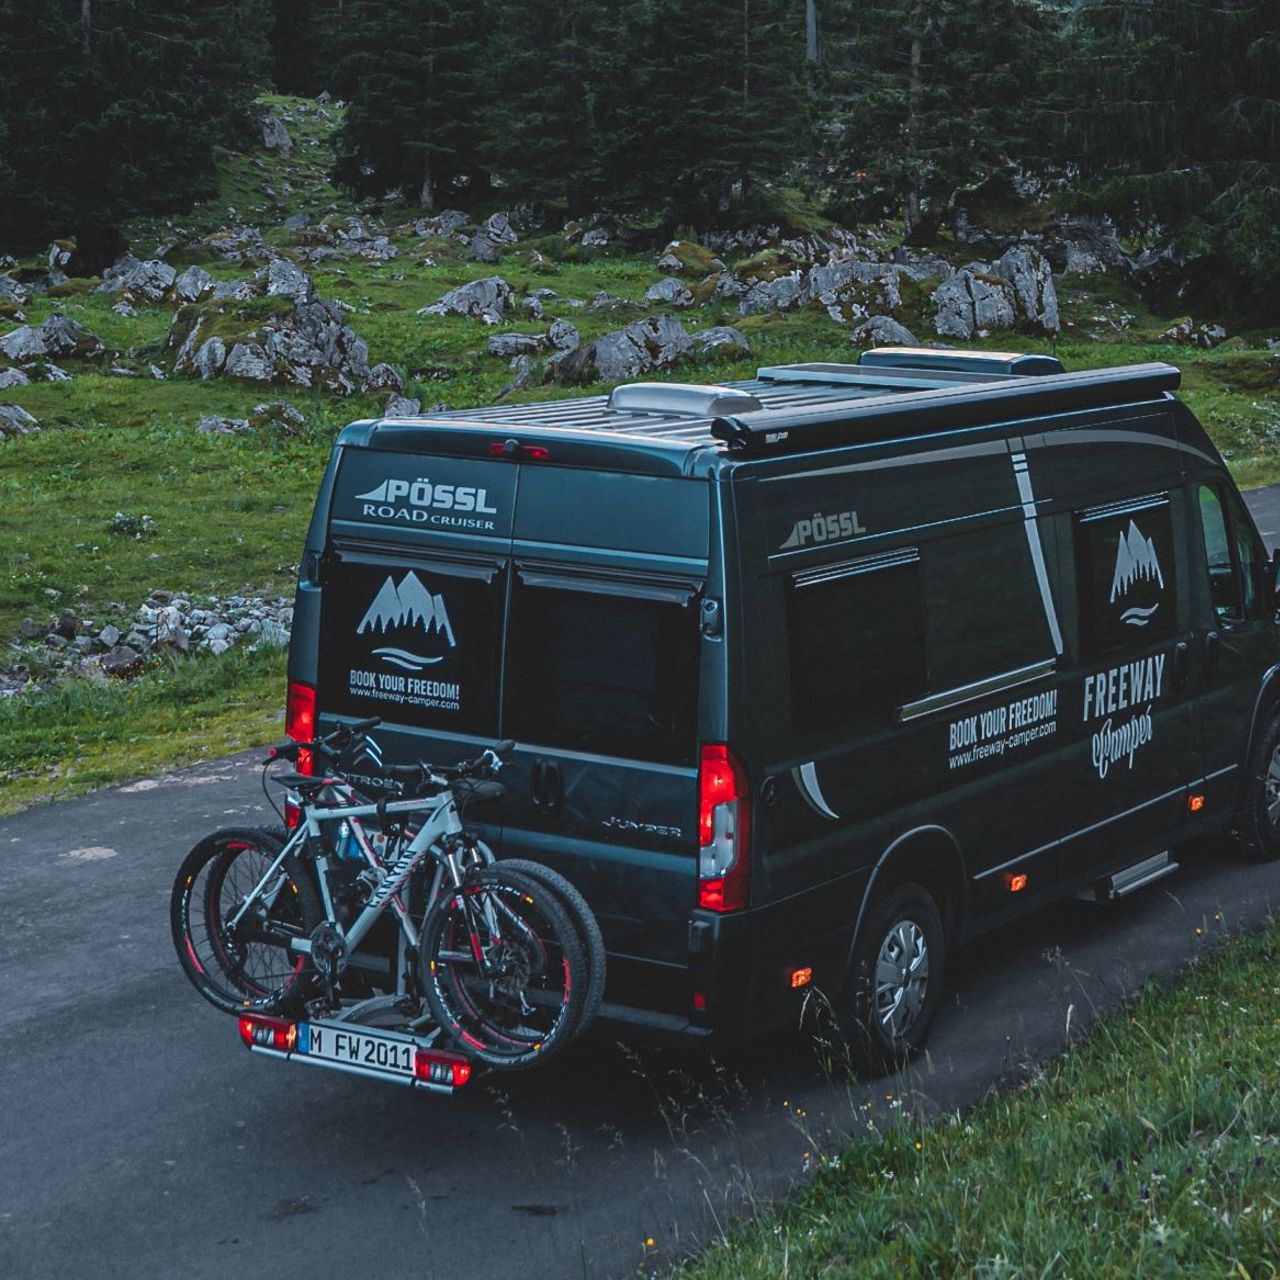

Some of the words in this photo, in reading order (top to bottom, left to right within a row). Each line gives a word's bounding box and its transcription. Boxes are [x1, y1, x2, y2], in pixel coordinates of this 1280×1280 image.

[363, 504, 428, 522] ROAD
[431, 515, 495, 530] CRUISER
[387, 477, 497, 514] PÖSSL
[797, 511, 866, 545] PÖSSL
[349, 687, 460, 710] www.freeway-camper.com
[350, 669, 377, 688] BOOK
[379, 674, 405, 692] YOUR
[407, 678, 460, 700] FREEDOM!
[1083, 653, 1165, 721] FREEWAY
[949, 715, 978, 751] BOOK
[980, 707, 1006, 740] YOUR
[1008, 689, 1058, 730] FREEDOM!
[1092, 704, 1153, 779] Camper
[948, 720, 1057, 769] www.freeway-camper.com
[369, 849, 417, 908] CANYON
[310, 1027, 322, 1053] M
[335, 1034, 360, 1061] FW
[364, 1039, 414, 1072] 2011
